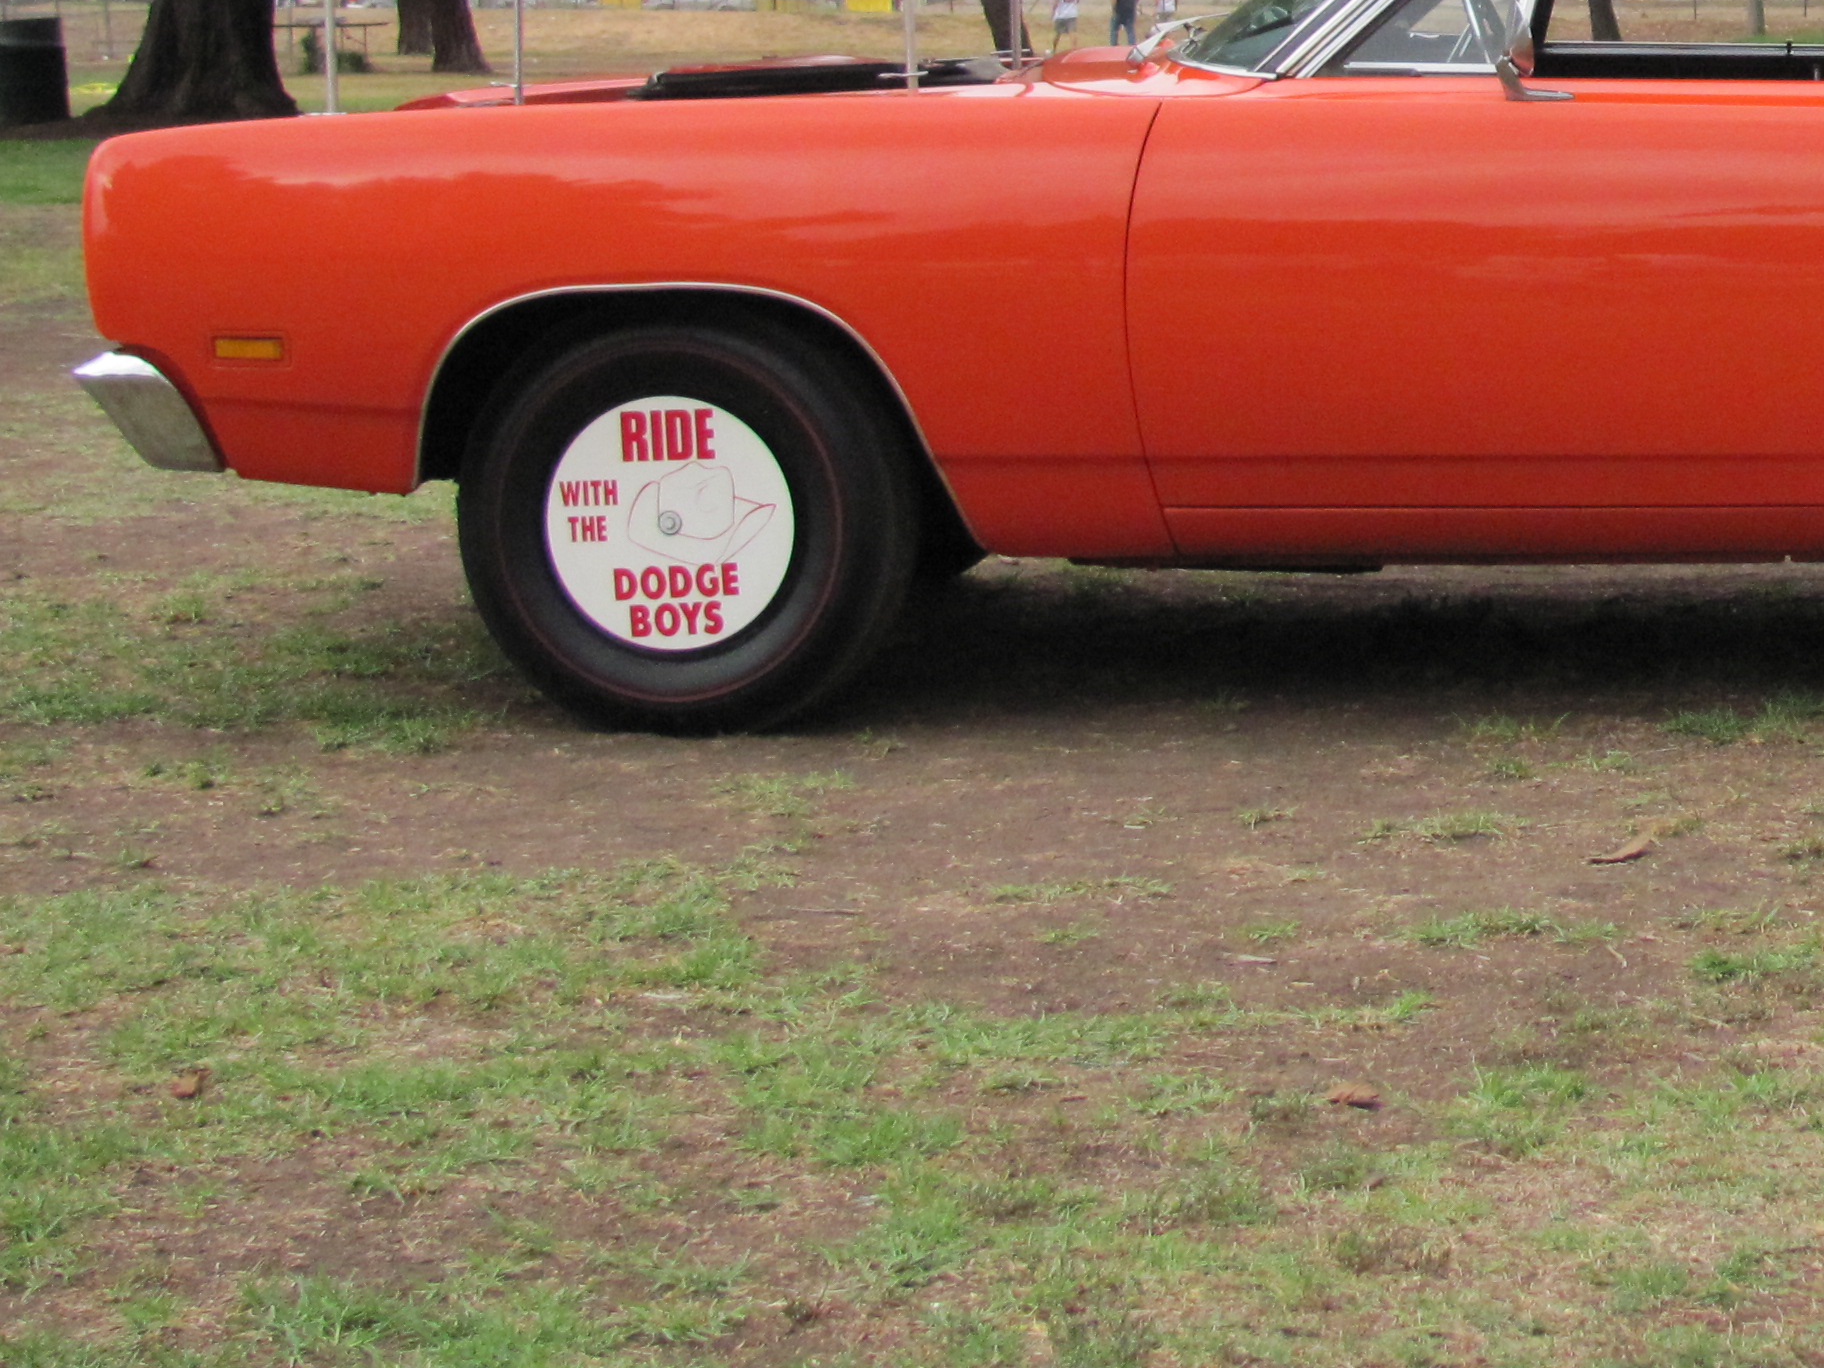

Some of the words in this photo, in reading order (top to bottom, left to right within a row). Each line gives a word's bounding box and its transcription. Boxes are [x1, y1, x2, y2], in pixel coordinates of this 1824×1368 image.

[620, 408, 716, 462] RIDE
[559, 479, 619, 507] WITH
[568, 515, 608, 543] THE
[613, 562, 740, 601] DODGE
[630, 600, 725, 638] BOYS
